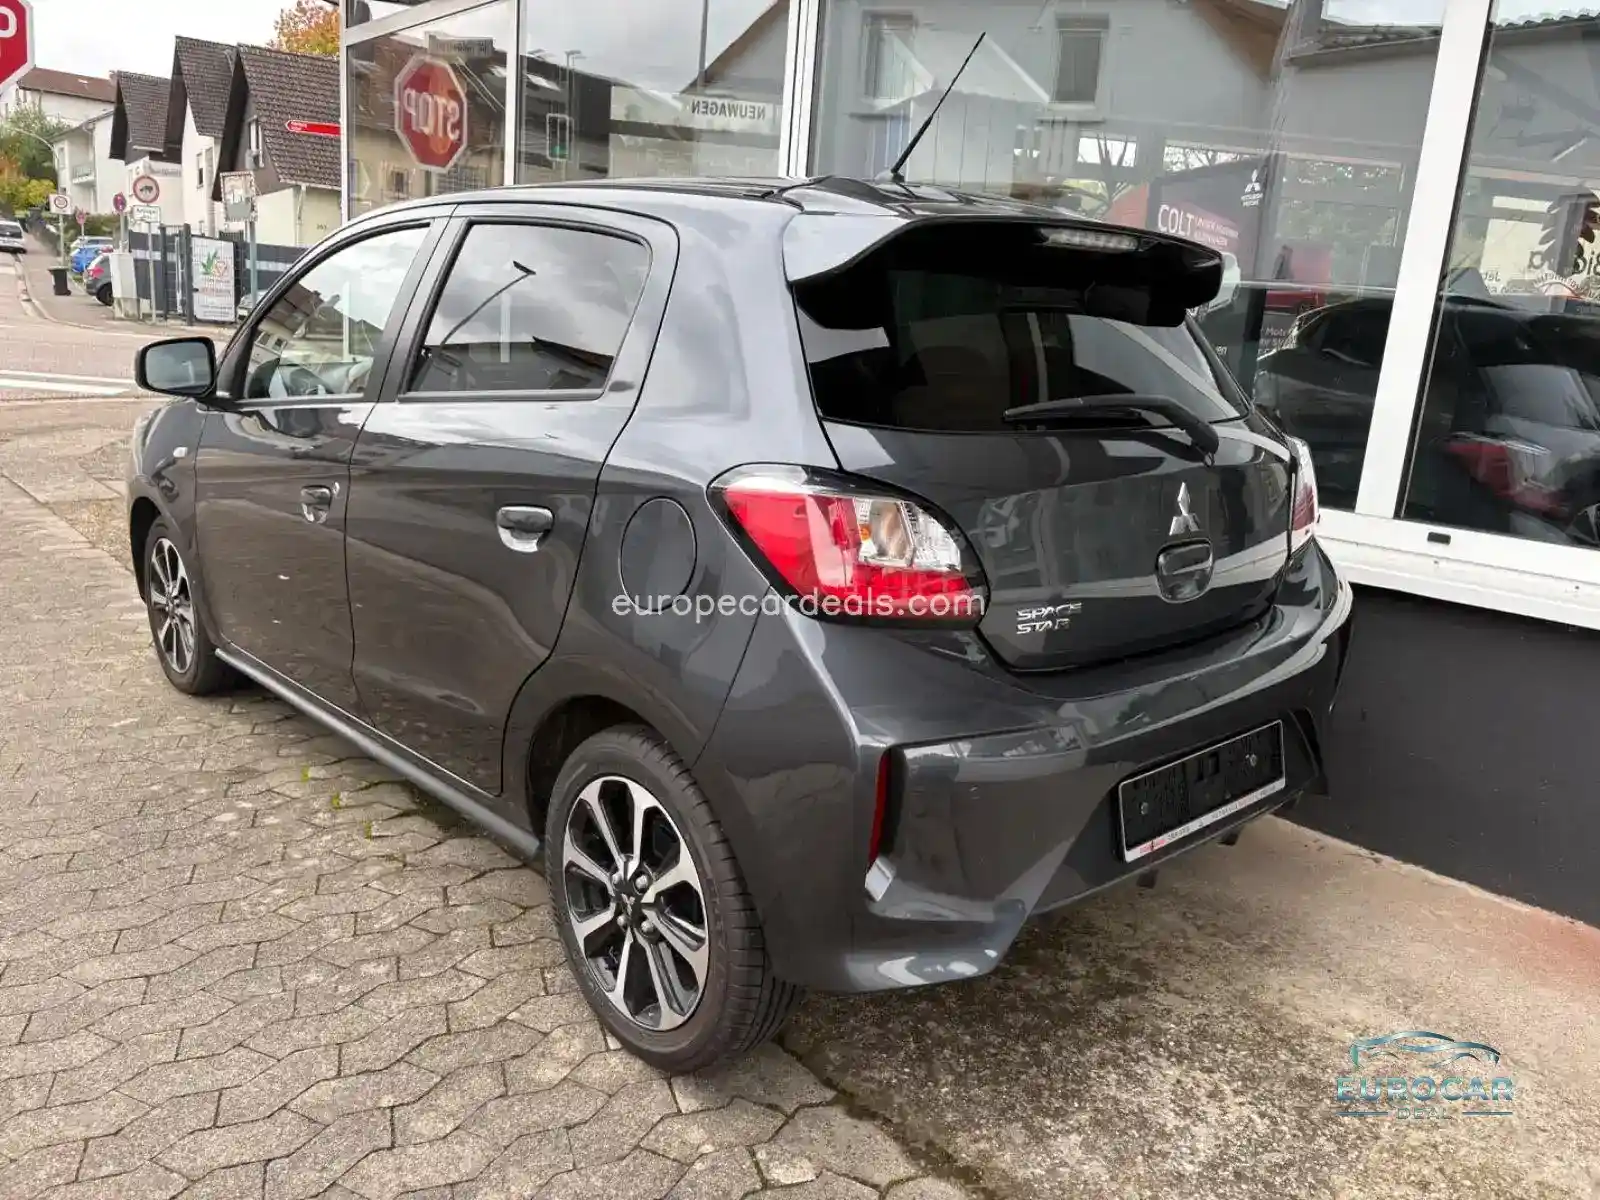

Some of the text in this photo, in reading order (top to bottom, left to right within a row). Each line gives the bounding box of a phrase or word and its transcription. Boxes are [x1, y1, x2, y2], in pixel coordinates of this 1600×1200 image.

[1158, 203, 1195, 237] COLT
[1016, 602, 1082, 621] SPACE
[1016, 618, 1070, 635] STAR
